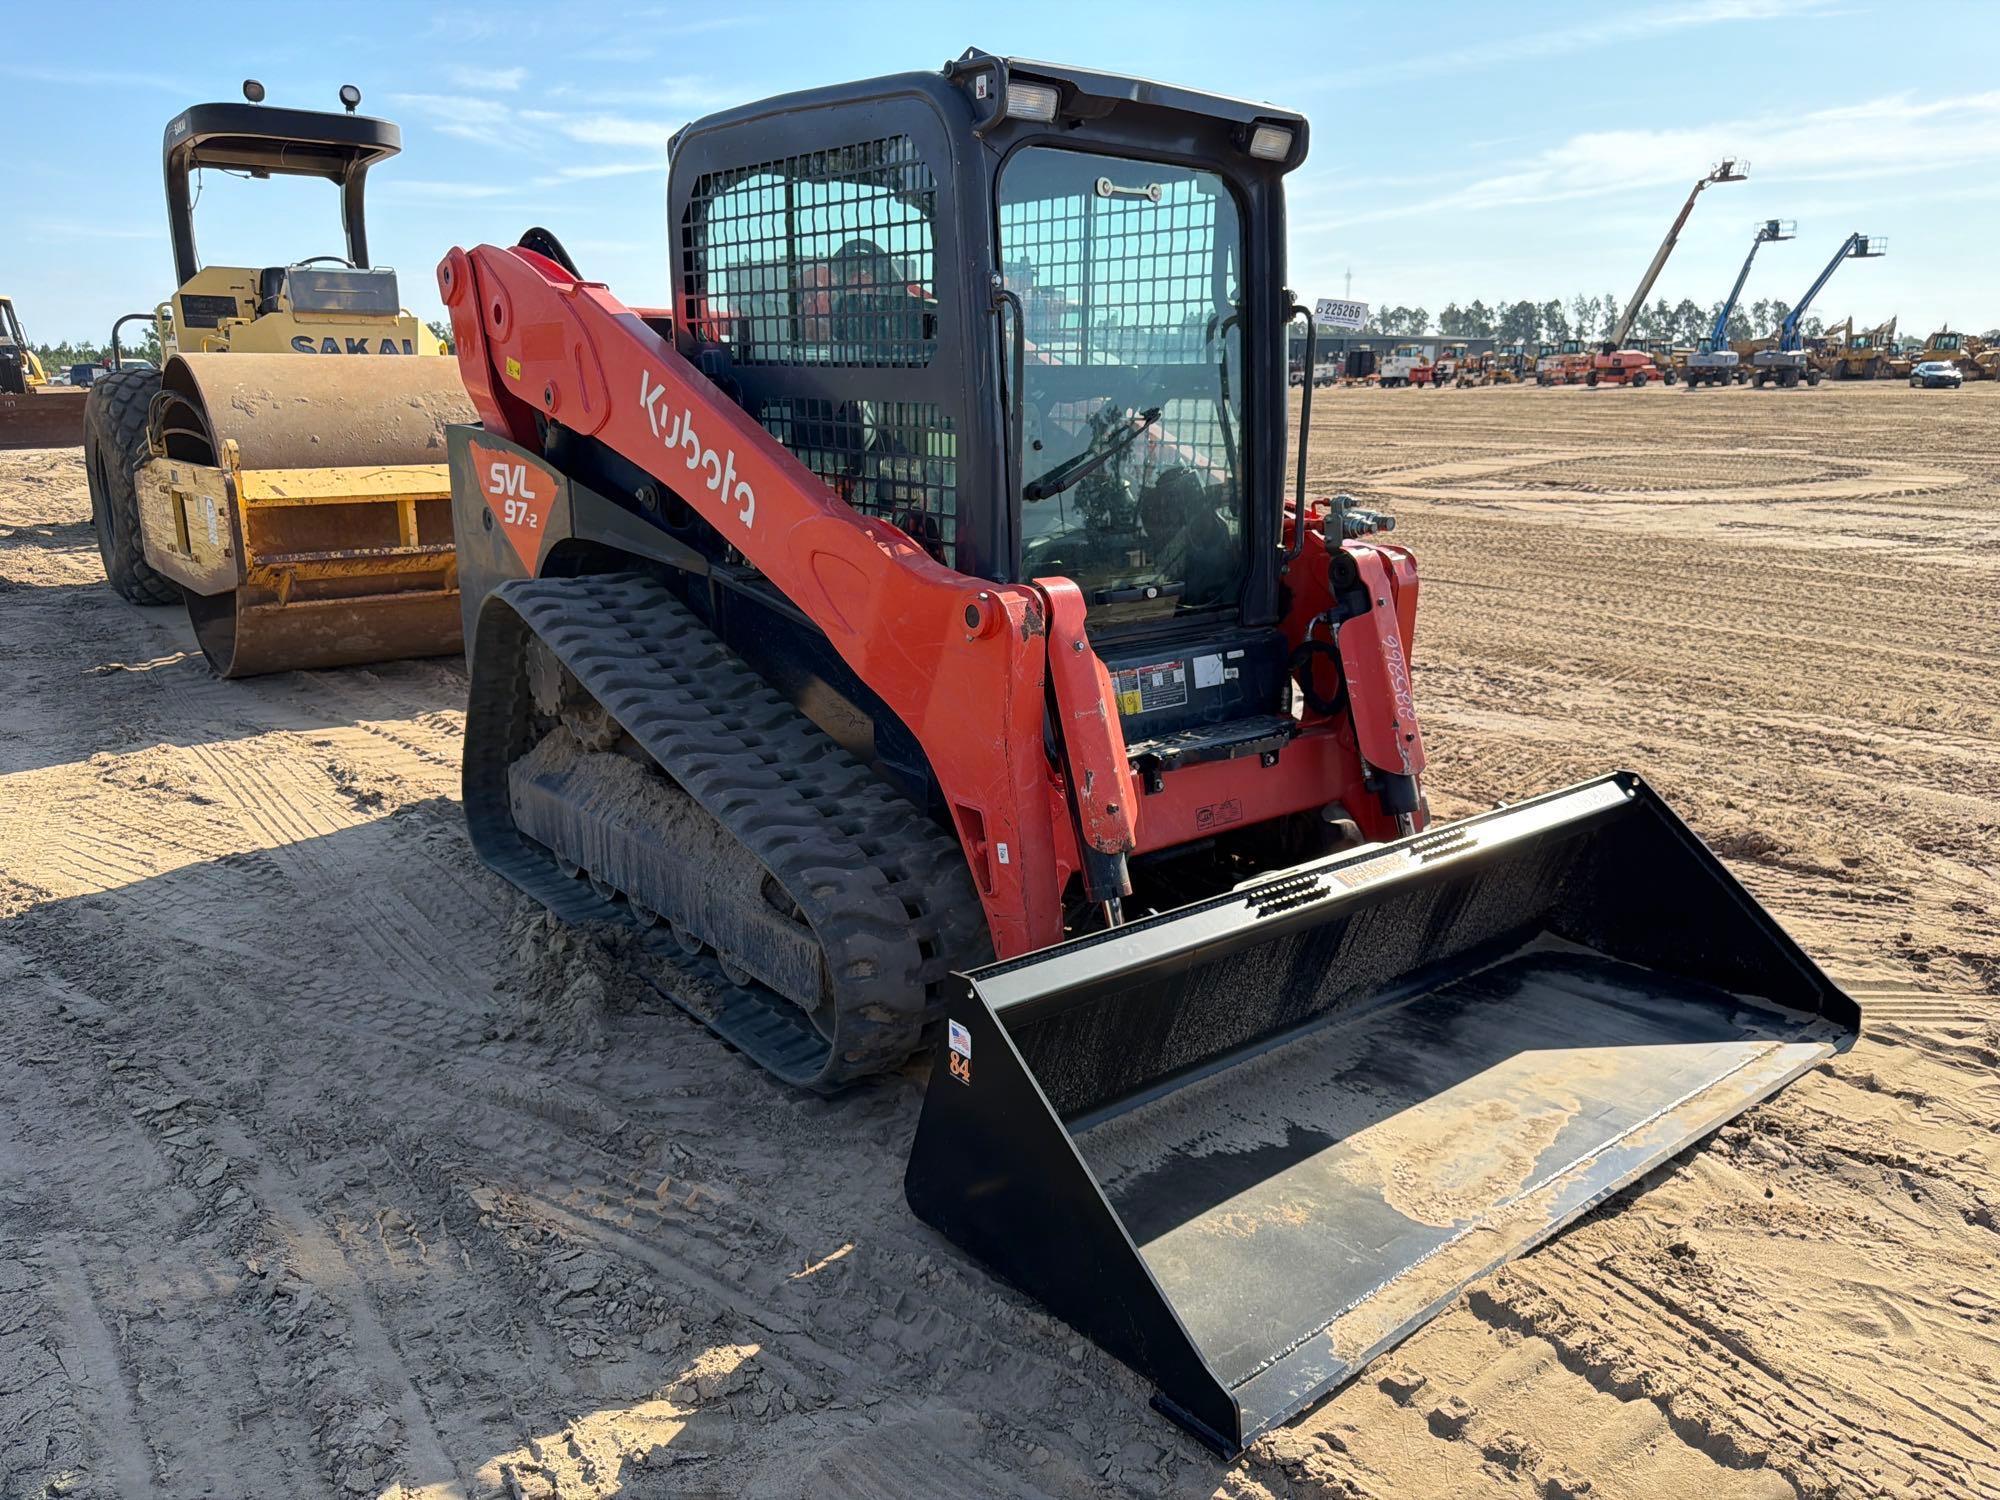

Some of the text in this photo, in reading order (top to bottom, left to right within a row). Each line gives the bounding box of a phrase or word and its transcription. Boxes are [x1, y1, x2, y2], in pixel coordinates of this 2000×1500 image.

[1324, 302, 1362, 319] 225266
[639, 368, 756, 529] Kubota
[489, 462, 536, 499] SVL
[1381, 634, 1417, 721] 225266
[949, 1050, 971, 1083] 84
